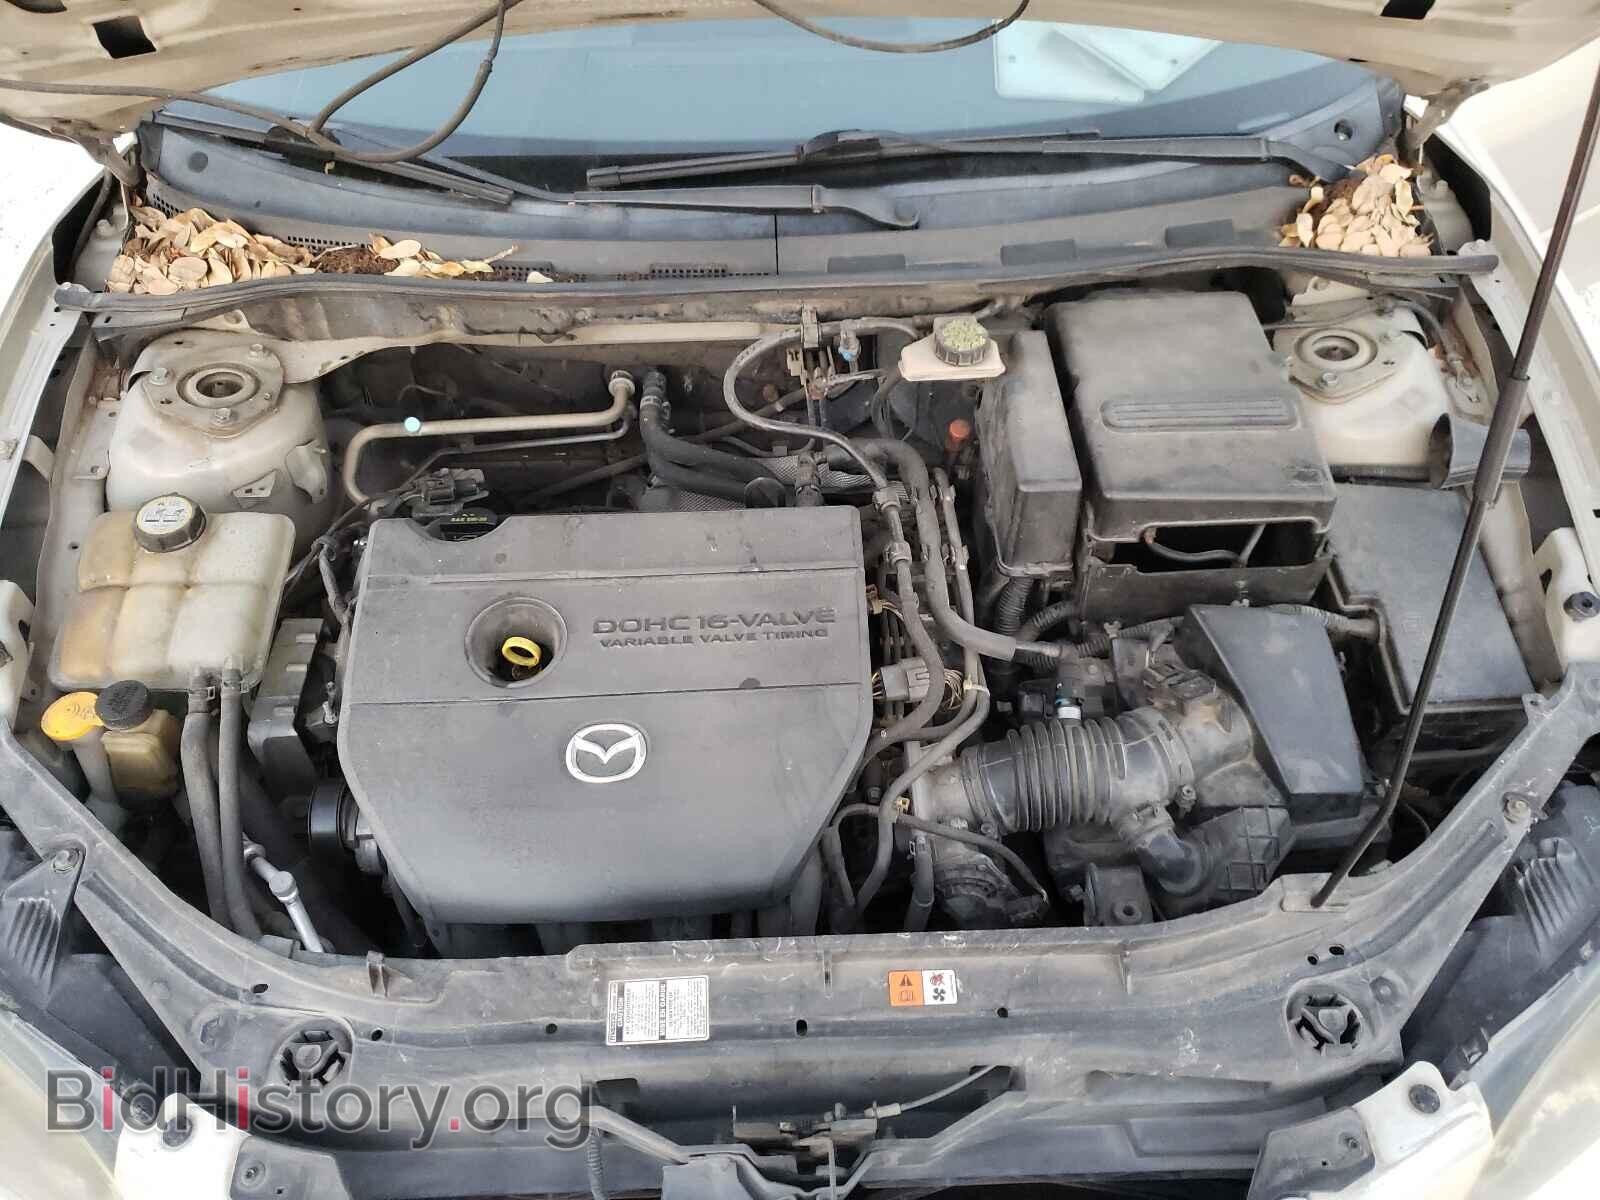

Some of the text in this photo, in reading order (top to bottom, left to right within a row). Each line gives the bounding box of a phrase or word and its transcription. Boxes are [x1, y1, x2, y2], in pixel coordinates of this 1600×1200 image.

[592, 607, 836, 635] DOHC 16-VALVE
[599, 628, 828, 648] VARIABLE VALVE TIMING
